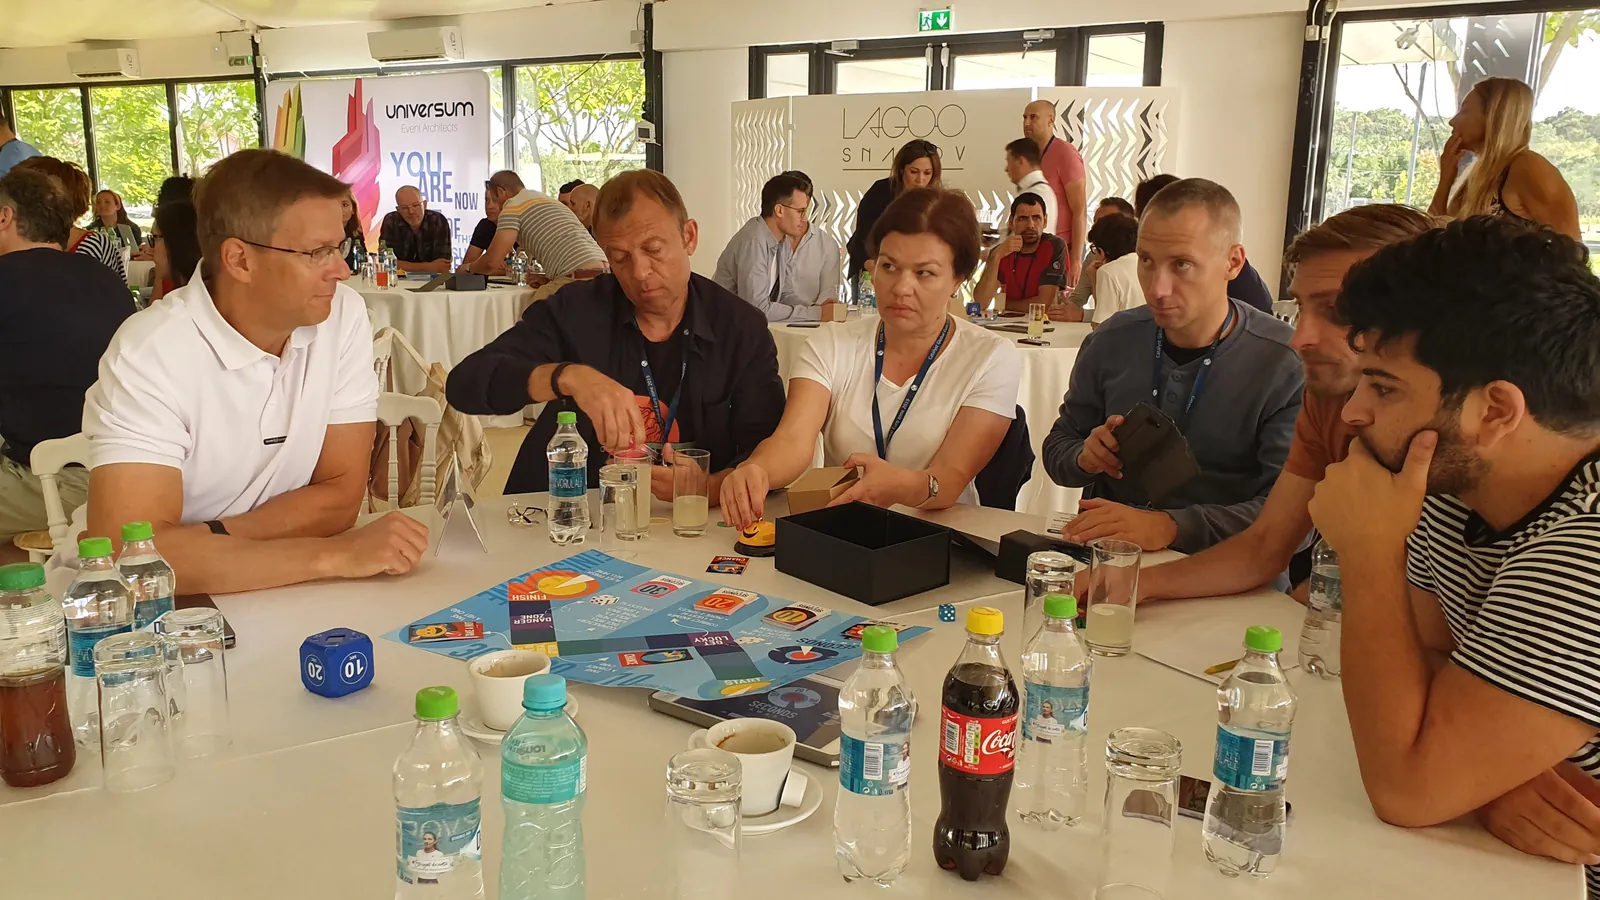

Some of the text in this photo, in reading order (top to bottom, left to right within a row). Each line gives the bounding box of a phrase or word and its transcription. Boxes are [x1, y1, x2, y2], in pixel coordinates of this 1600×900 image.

[386, 101, 474, 119] universum
[401, 123, 458, 133] Event Architects
[843, 104, 967, 140] LAGOO
[390, 151, 442, 177] YOU
[419, 171, 453, 203] ARE
[454, 192, 479, 210] NOW
[640, 585, 668, 595] 30
[704, 597, 734, 608] 20
[513, 616, 552, 625] DANGER
[776, 611, 803, 620] 10
[694, 635, 729, 644] LUCKY
[796, 637, 860, 650] SECONDS
[308, 662, 323, 681] 20
[345, 659, 364, 678] 10
[724, 677, 763, 686] START
[748, 700, 799, 719] SECONDS
